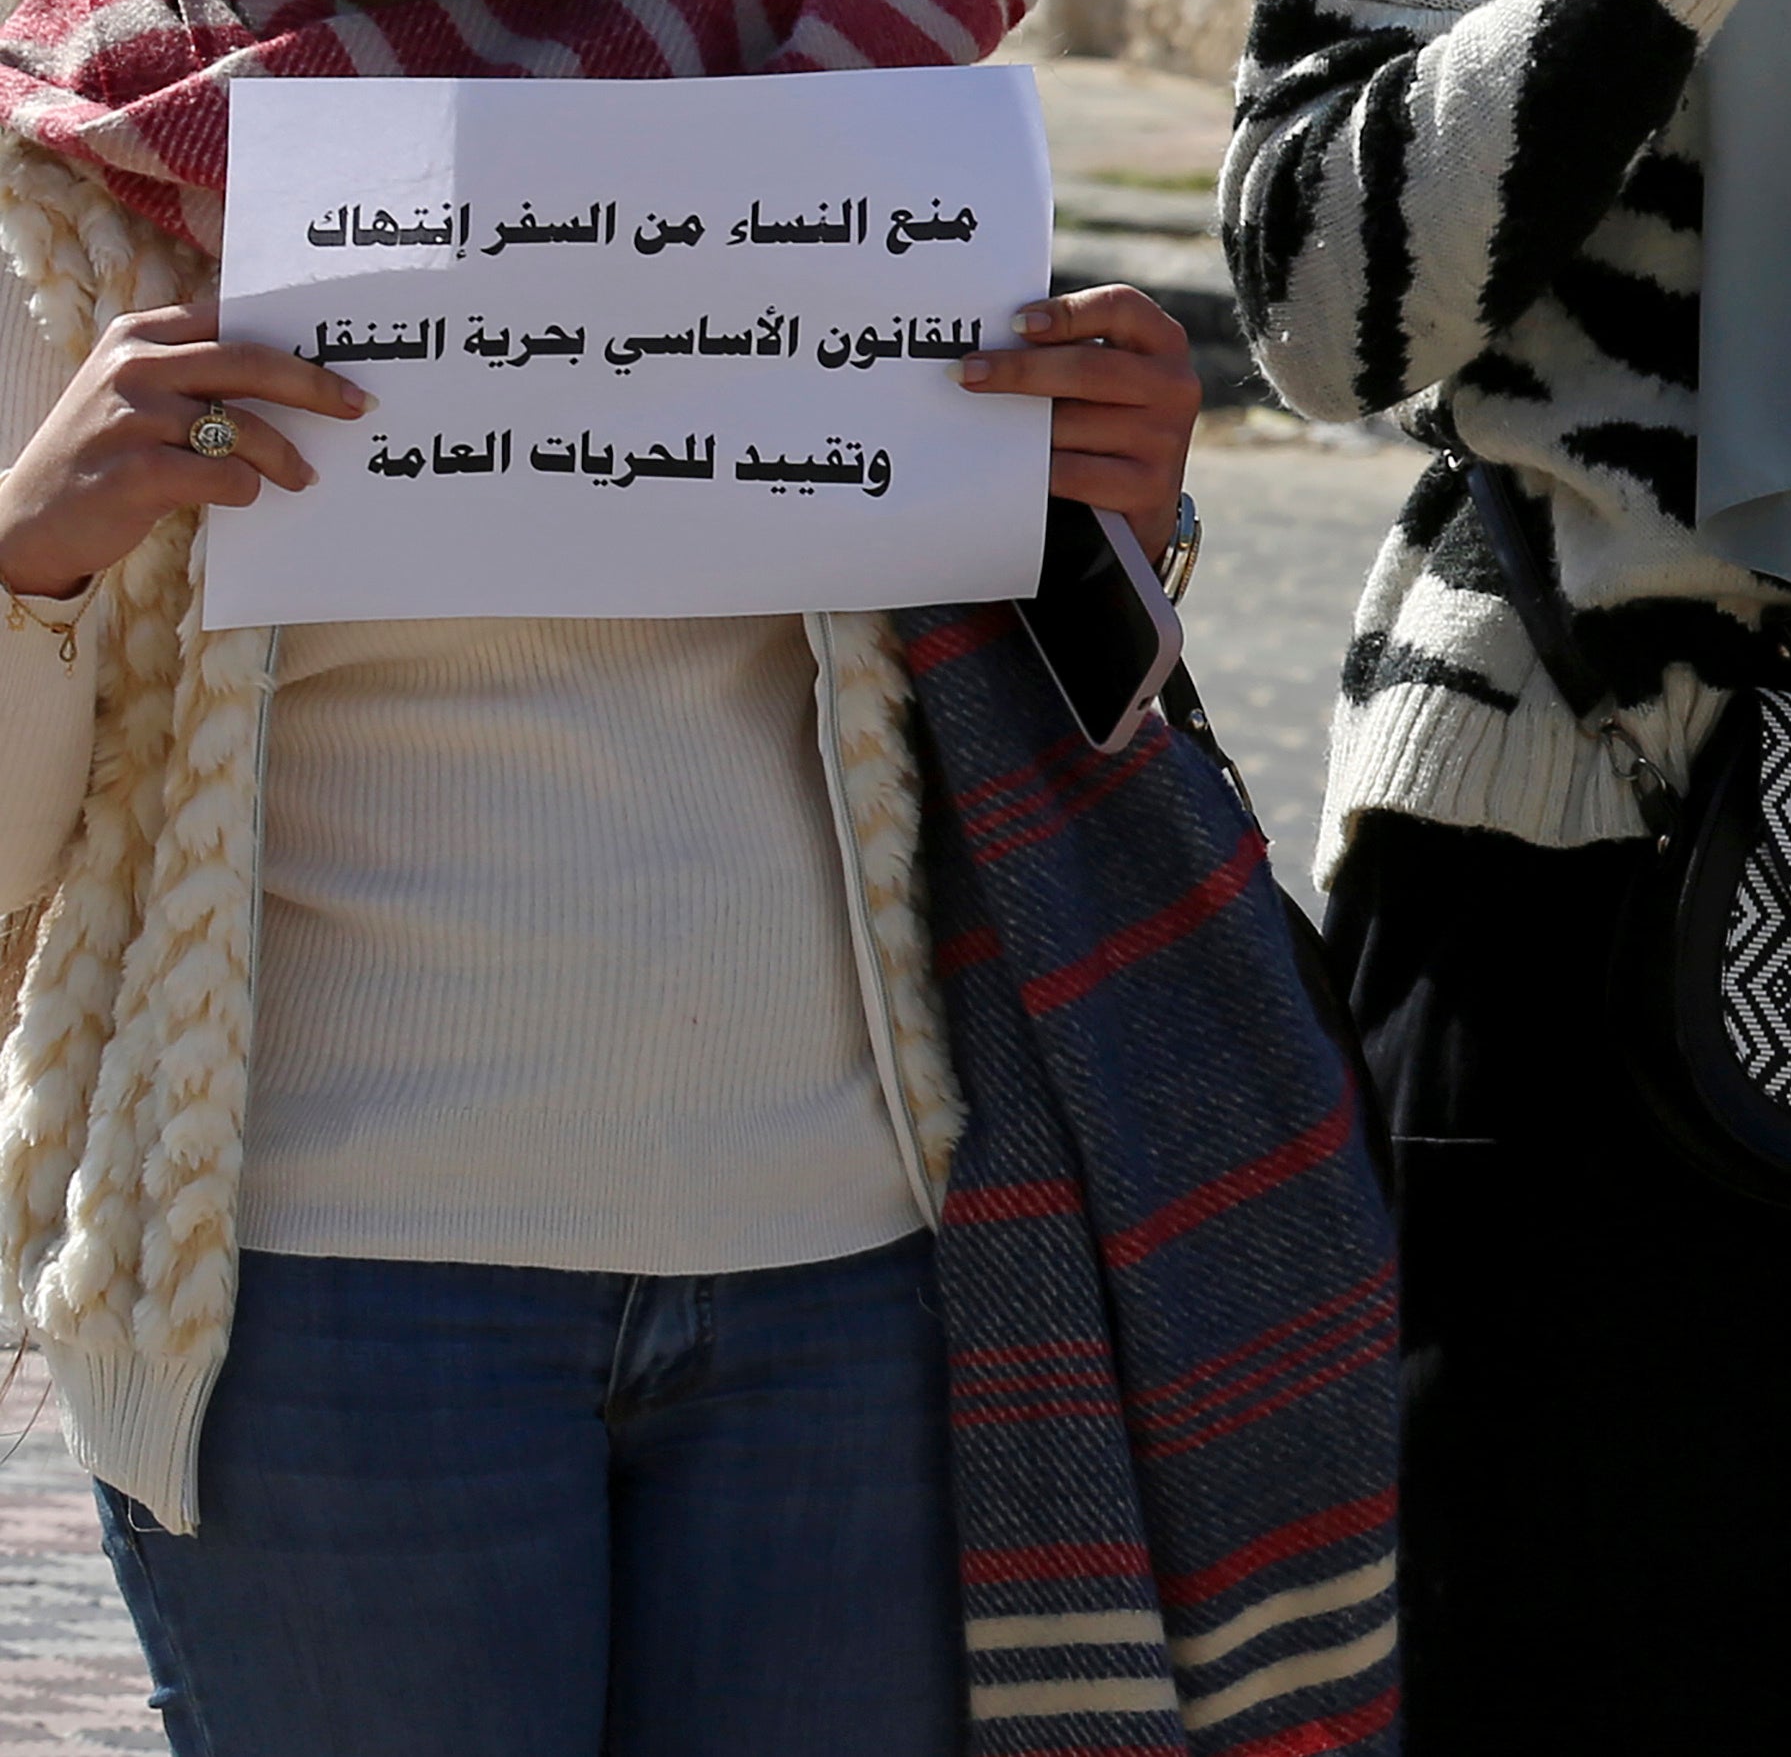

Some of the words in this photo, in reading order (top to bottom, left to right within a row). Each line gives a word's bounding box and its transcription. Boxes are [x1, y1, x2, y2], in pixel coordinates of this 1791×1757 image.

[307, 201, 471, 260] إنتهاك
[480, 200, 617, 256] السفر
[633, 212, 706, 256] من
[726, 196, 868, 246] النساء
[885, 197, 978, 255] منع
[293, 314, 447, 368] التنقل
[463, 314, 586, 369] بحرية
[604, 304, 800, 376] الأساسي
[816, 315, 983, 370] للقانون
[367, 427, 512, 479] العامة
[529, 428, 716, 489] للحريات
[735, 435, 892, 498] وتقييد
